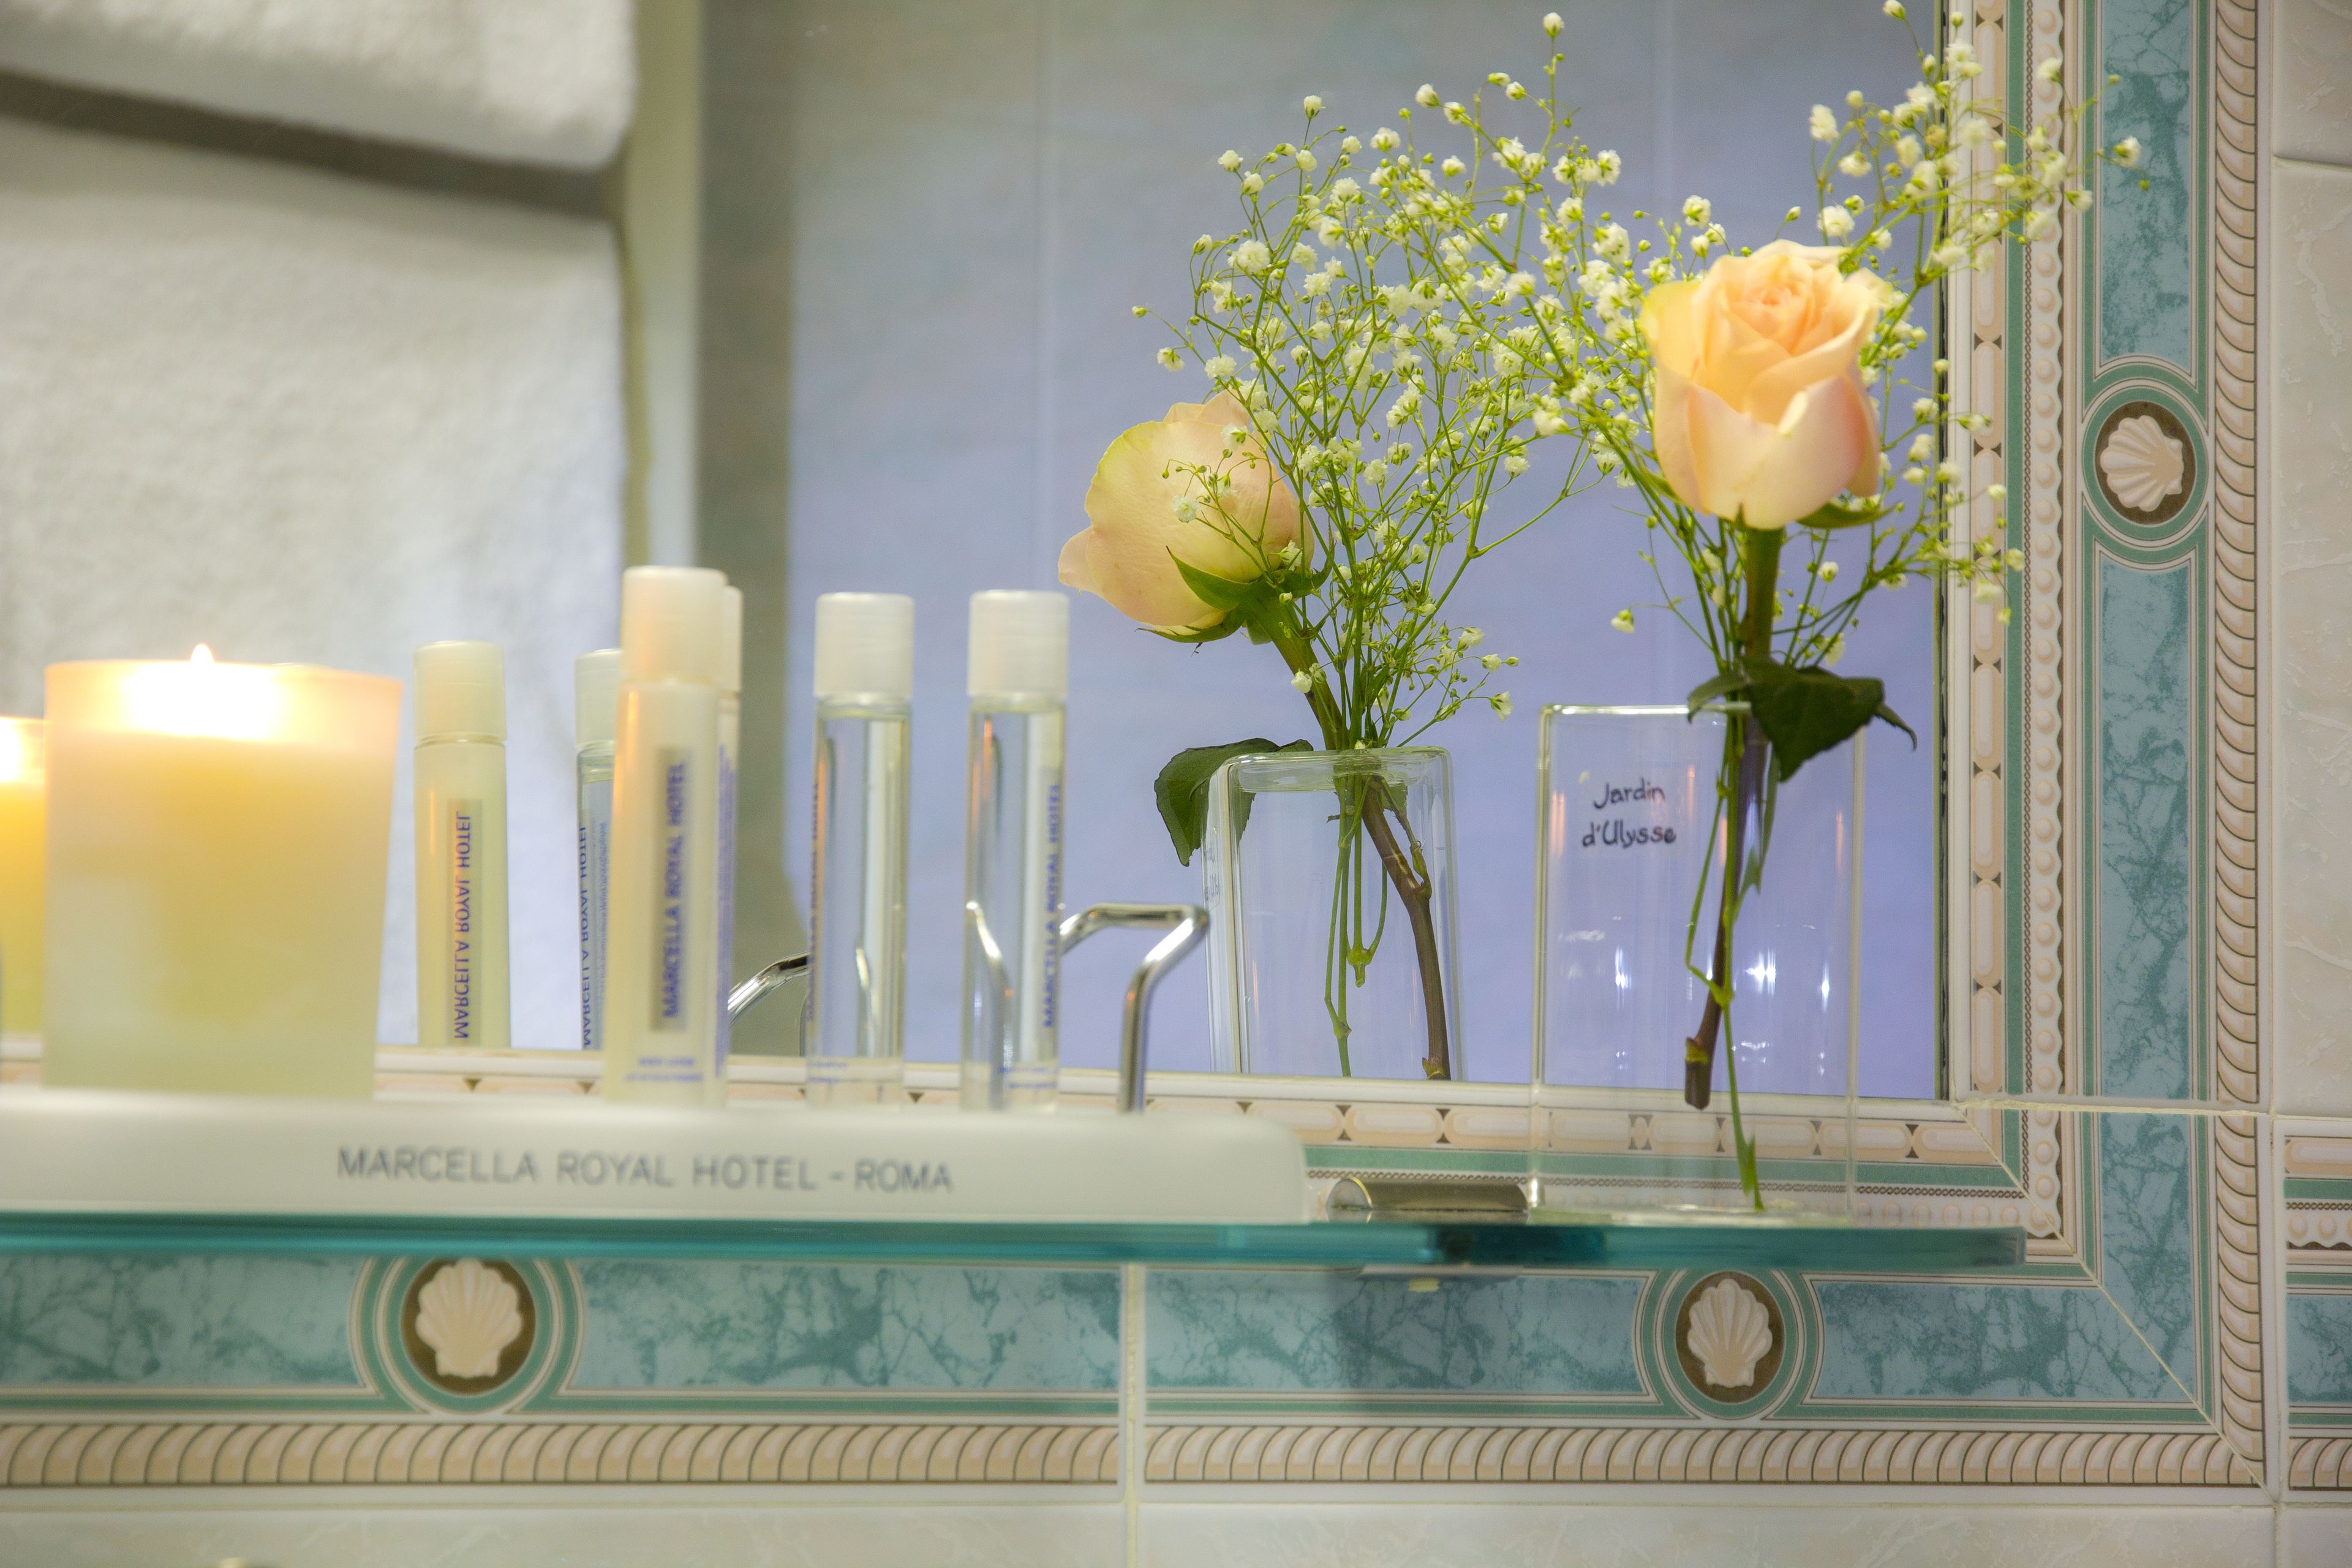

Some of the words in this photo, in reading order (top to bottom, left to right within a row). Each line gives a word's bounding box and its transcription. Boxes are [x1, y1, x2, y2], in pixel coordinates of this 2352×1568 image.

[1593, 777, 1665, 809] Jardin
[1582, 819, 1676, 849] d'Ulysse
[338, 1145, 538, 1183] MARCELLA
[557, 1149, 674, 1187] ROYAL
[693, 1154, 816, 1189] HOTEL
[856, 1158, 953, 1192] ROMA
